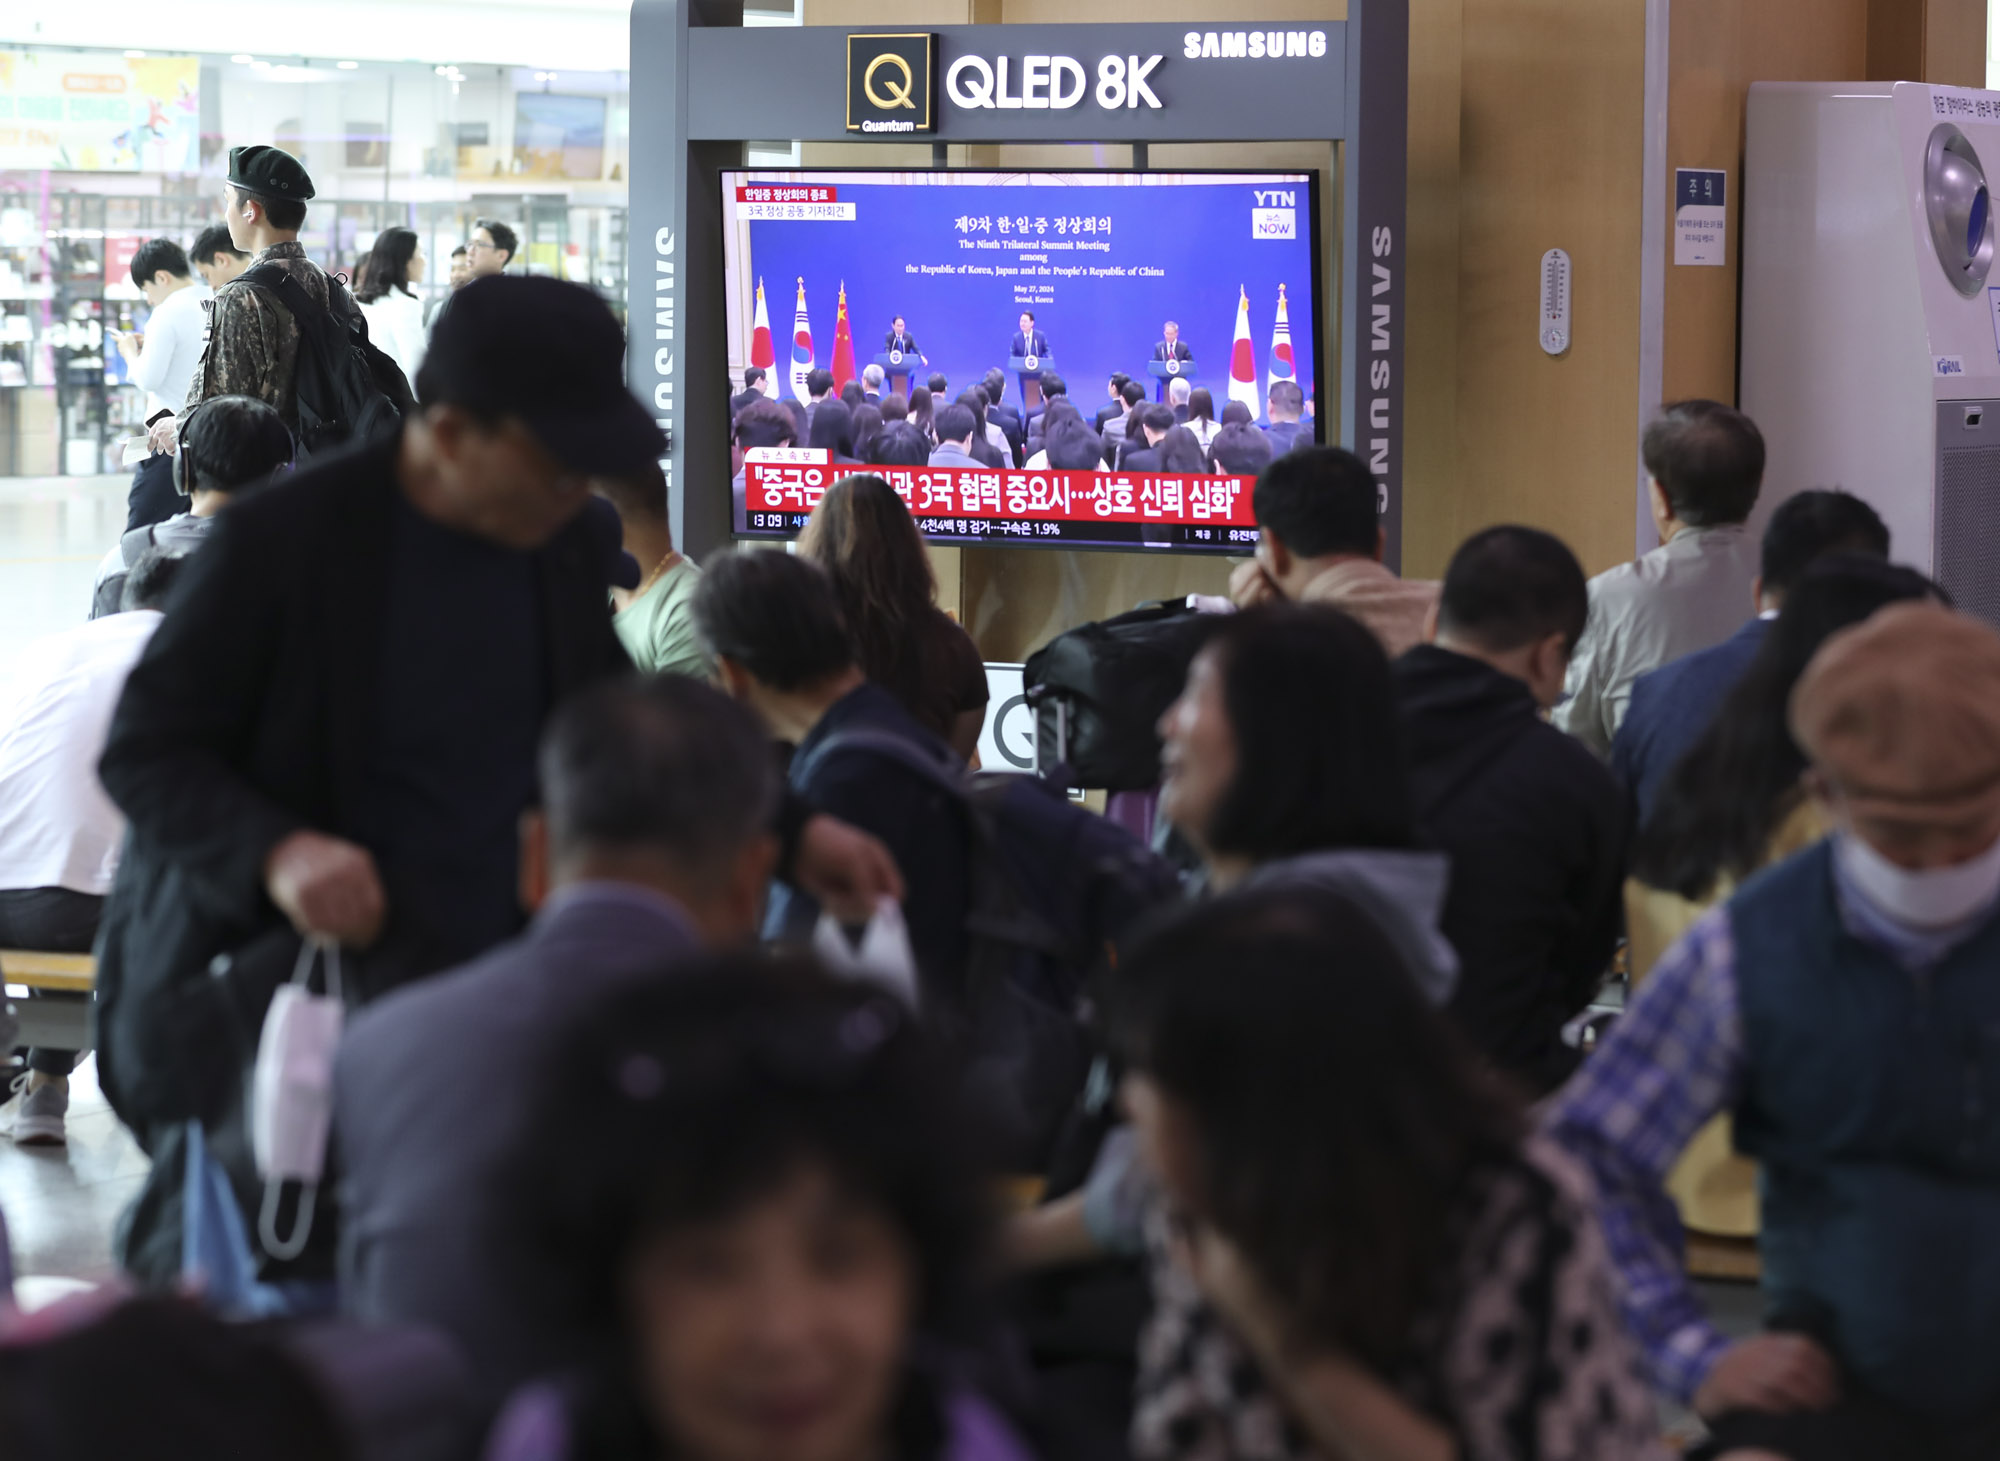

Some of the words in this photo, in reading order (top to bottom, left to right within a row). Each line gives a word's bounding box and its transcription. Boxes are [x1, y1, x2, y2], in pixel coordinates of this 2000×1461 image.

[1183, 31, 1327, 59] SAMSUNG
[864, 53, 916, 109] Q
[946, 55, 1087, 109] QLED
[1096, 55, 1164, 109] 8K
[861, 119, 914, 134] Quantum
[745, 188, 771, 201] 한일중
[773, 188, 809, 201] 정상회의
[810, 189, 829, 201] 종료
[1253, 190, 1295, 207] YTN
[748, 205, 763, 216] 3국
[765, 206, 784, 218] 정상
[786, 206, 805, 218] 공동
[808, 206, 845, 218] 기자회견
[1266, 213, 1281, 222] 뉴스
[954, 215, 992, 234] 제9차
[1053, 216, 1112, 235] 정상회의
[1259, 223, 1290, 234] NOW
[958, 239, 975, 249] The
[976, 239, 1000, 249] Ninth
[1001, 239, 1039, 250] Trilateral
[1041, 240, 1074, 250] Summit
[1076, 240, 1110, 252] Meeting
[1019, 254, 1048, 264] among
[905, 264, 919, 273] the
[920, 264, 956, 276] Republic
[957, 265, 967, 274] of
[968, 265, 994, 276] Korea,
[995, 265, 1018, 277] Japan
[1020, 265, 1036, 275] and
[1037, 265, 1051, 275] the
[1053, 266, 1087, 278] People's
[1089, 266, 1126, 278] Republic
[1127, 267, 1138, 276] of
[1138, 267, 1165, 277] China
[1013, 285, 1028, 294] May
[1014, 296, 1034, 304] Seoul,
[655, 226, 675, 487] SAMSU
[918, 474, 954, 511] 3국
[959, 474, 1000, 513] 협력
[1139, 478, 1184, 518] 신뢰
[767, 514, 782, 527] 09
[920, 519, 955, 533] 4천4백
[957, 520, 967, 533] 명
[1034, 523, 1060, 535] 1.9%
[1195, 529, 1211, 540] 제공
